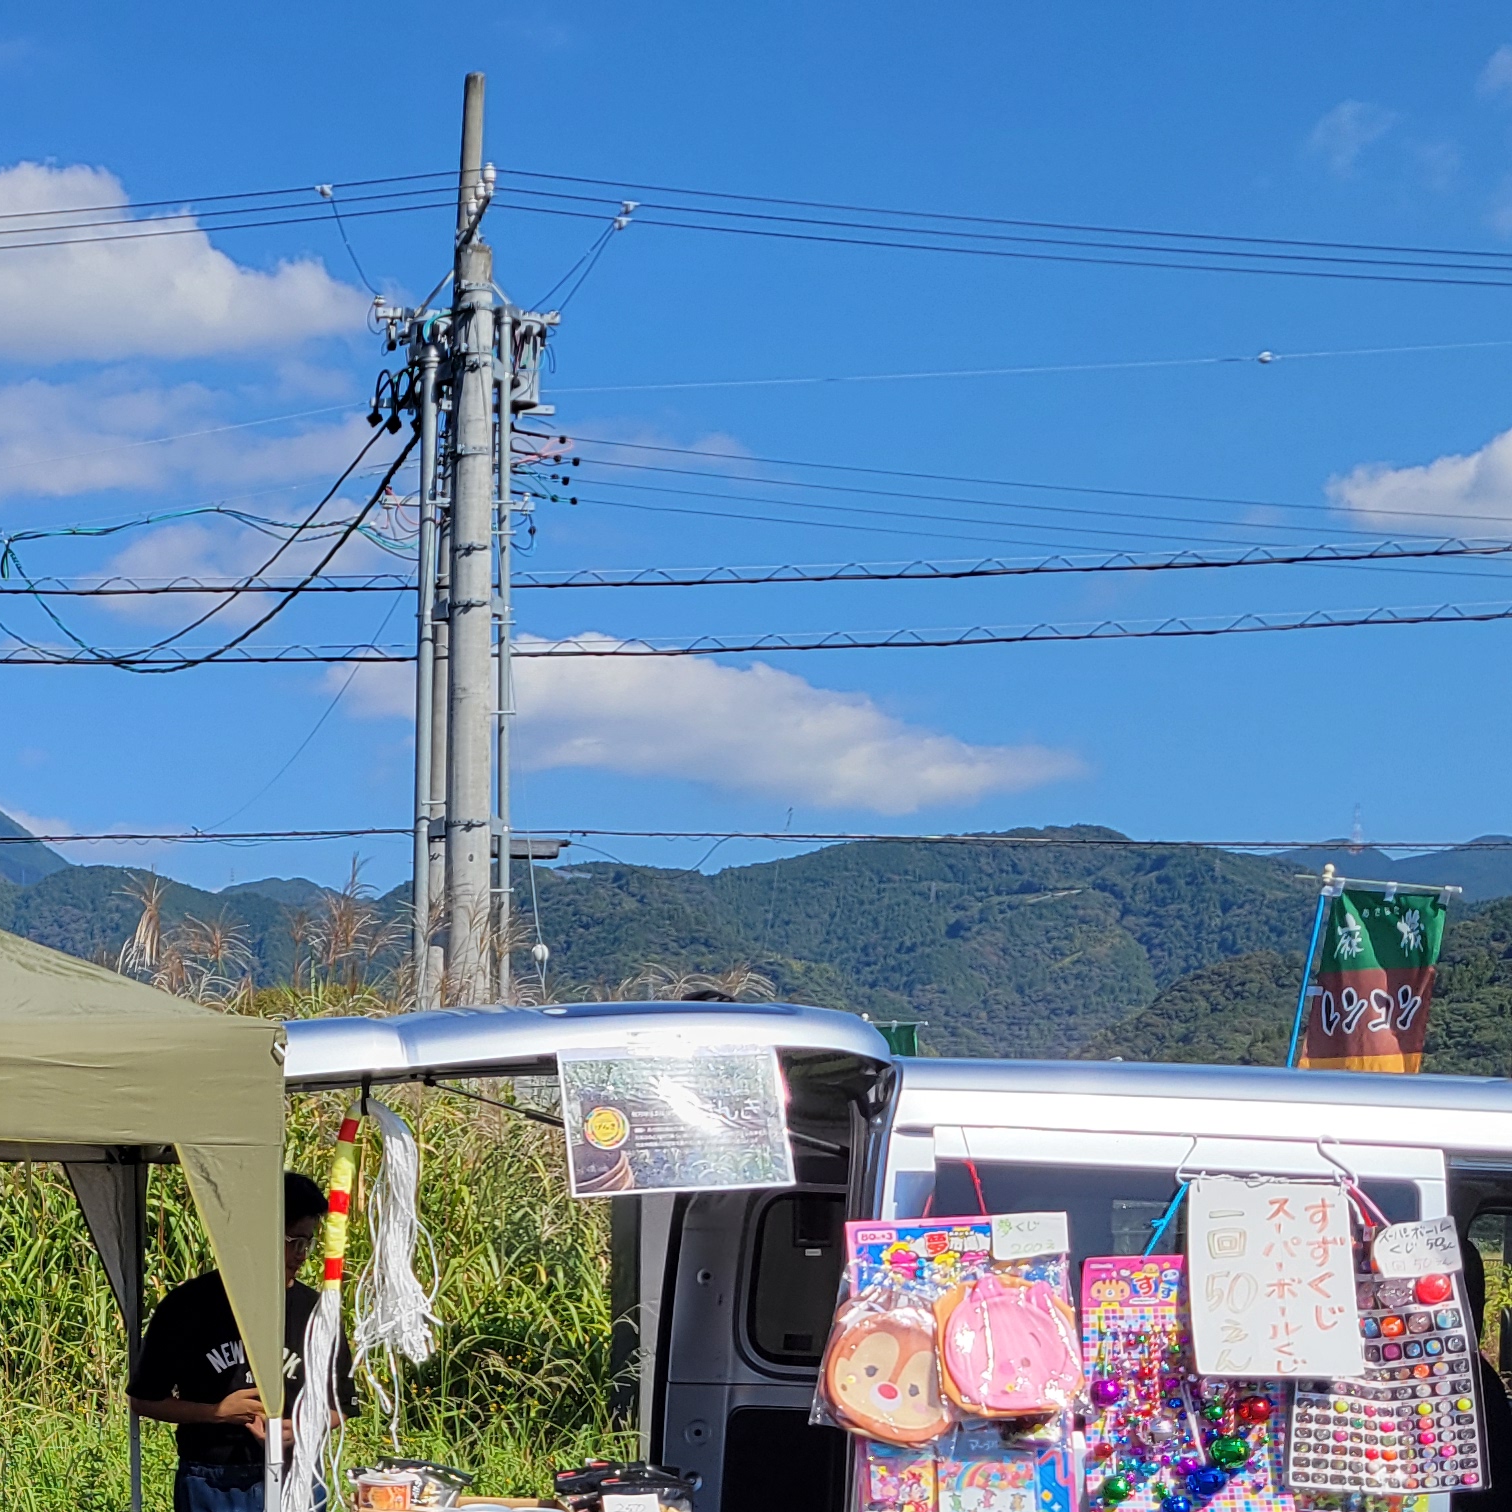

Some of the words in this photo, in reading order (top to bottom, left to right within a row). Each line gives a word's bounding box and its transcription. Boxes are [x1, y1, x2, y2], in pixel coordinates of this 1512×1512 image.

[1305, 1197, 1346, 1331] すずくじ
[206, 1340, 245, 1373] NEW
